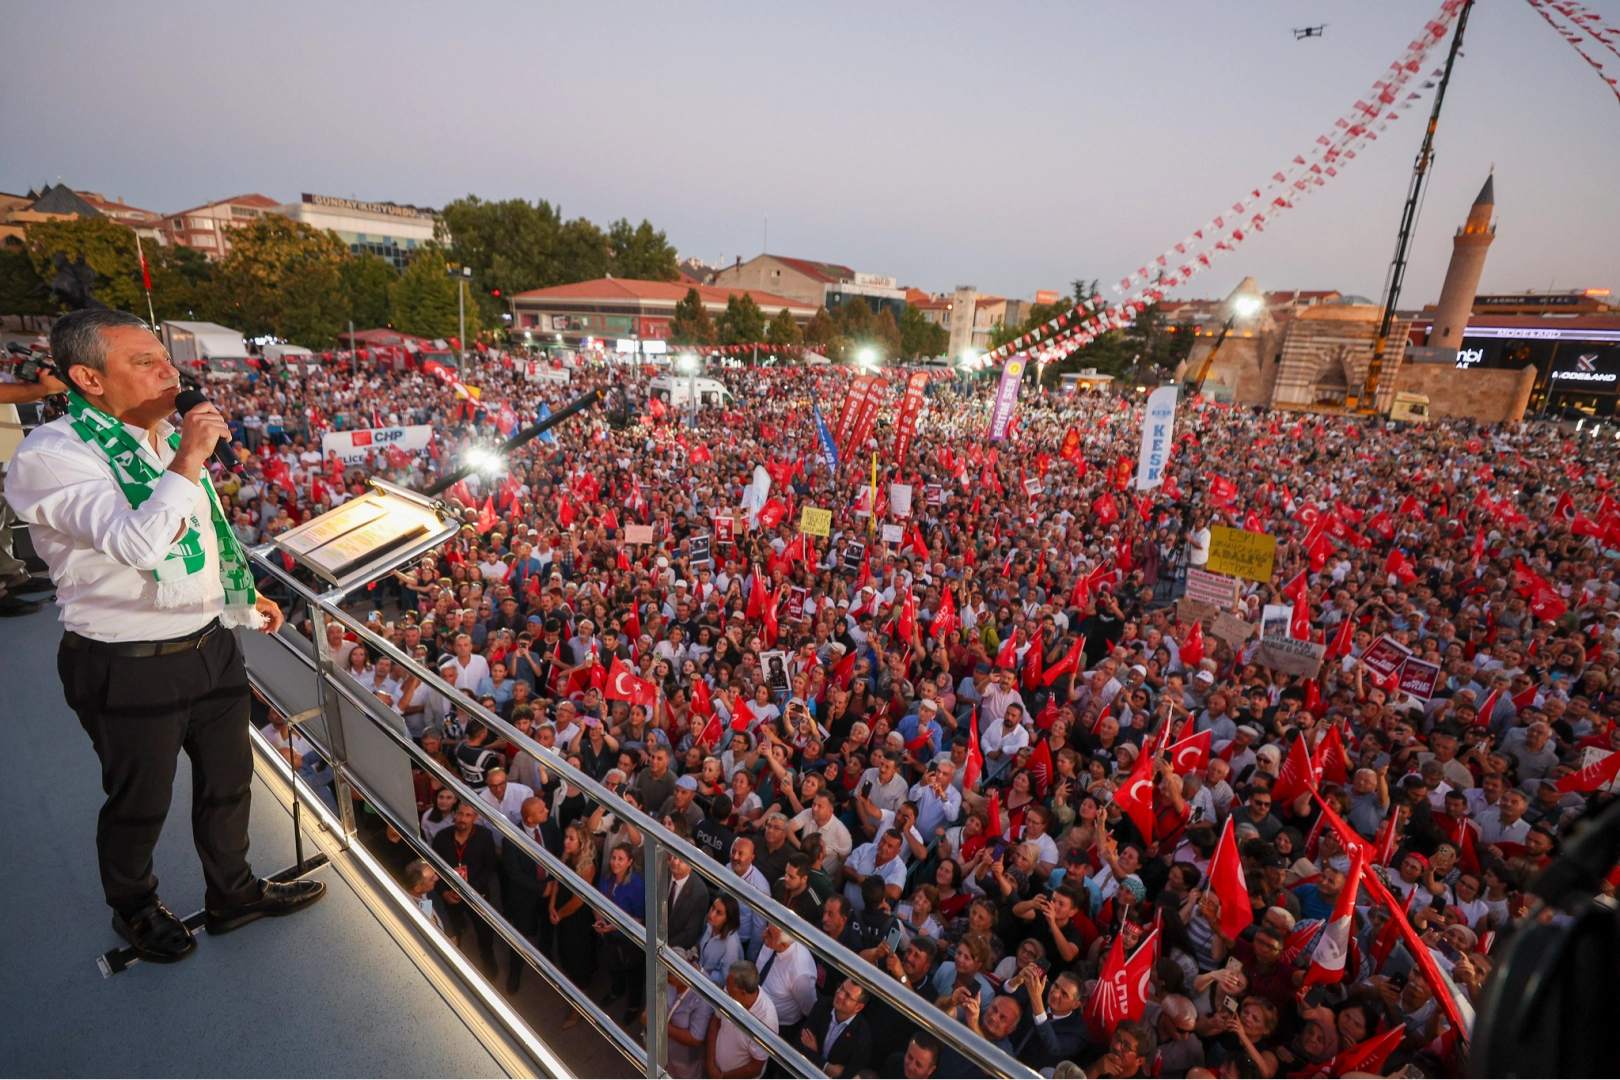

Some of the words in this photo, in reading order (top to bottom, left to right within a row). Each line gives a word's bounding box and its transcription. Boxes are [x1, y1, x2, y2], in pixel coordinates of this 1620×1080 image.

[381, 204, 416, 217] YURDU
[1003, 378, 1017, 400] SEN
[374, 430, 403, 442] CHP
[1148, 424, 1165, 480] KESK
[696, 829, 723, 850] POLİS
